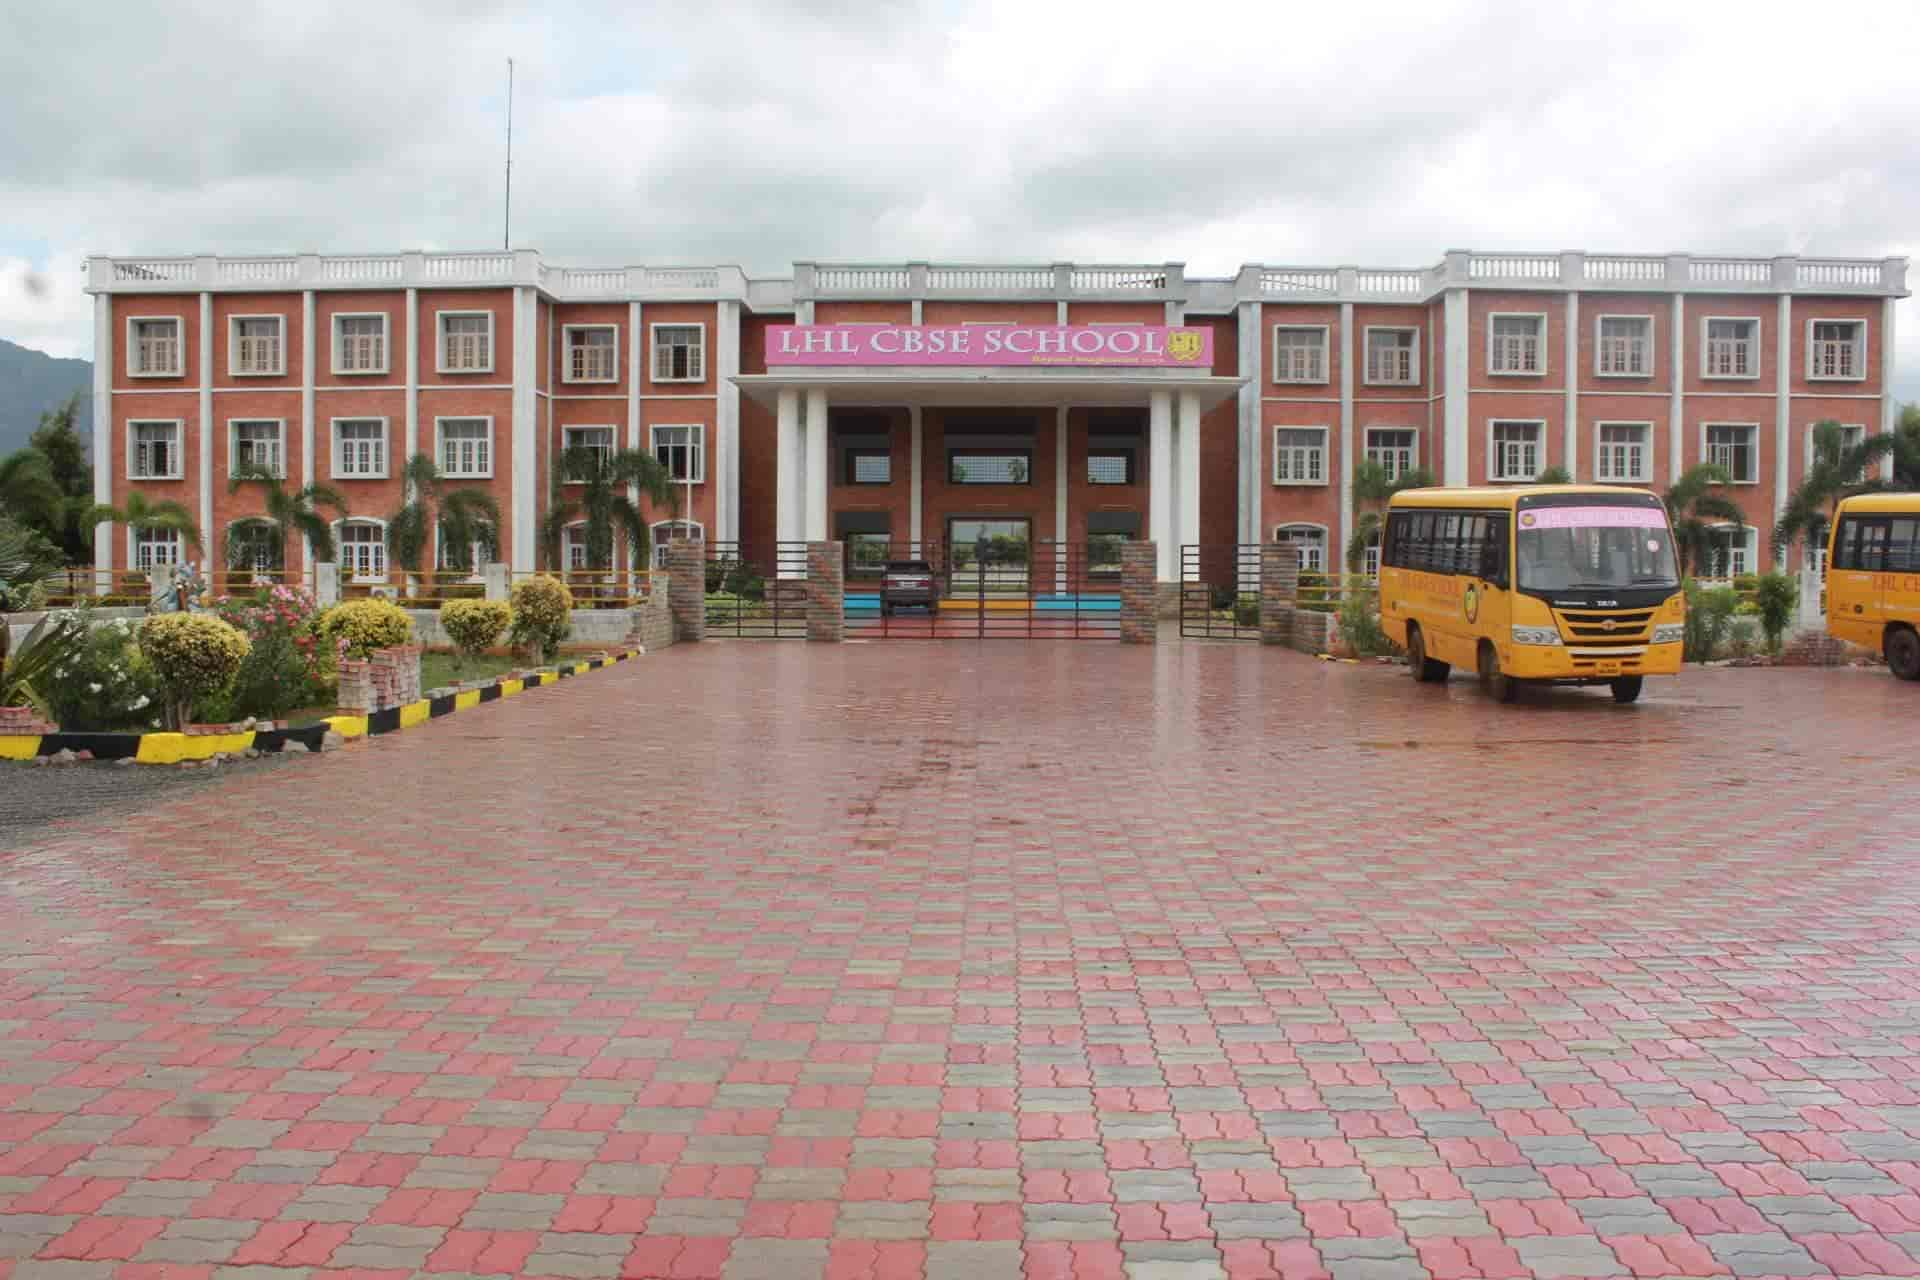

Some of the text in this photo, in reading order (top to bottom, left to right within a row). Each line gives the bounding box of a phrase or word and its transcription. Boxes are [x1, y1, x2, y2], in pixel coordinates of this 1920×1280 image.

[779, 329, 859, 356] LHL
[870, 328, 969, 355] CBSE
[983, 328, 1164, 356] SCHOOL
